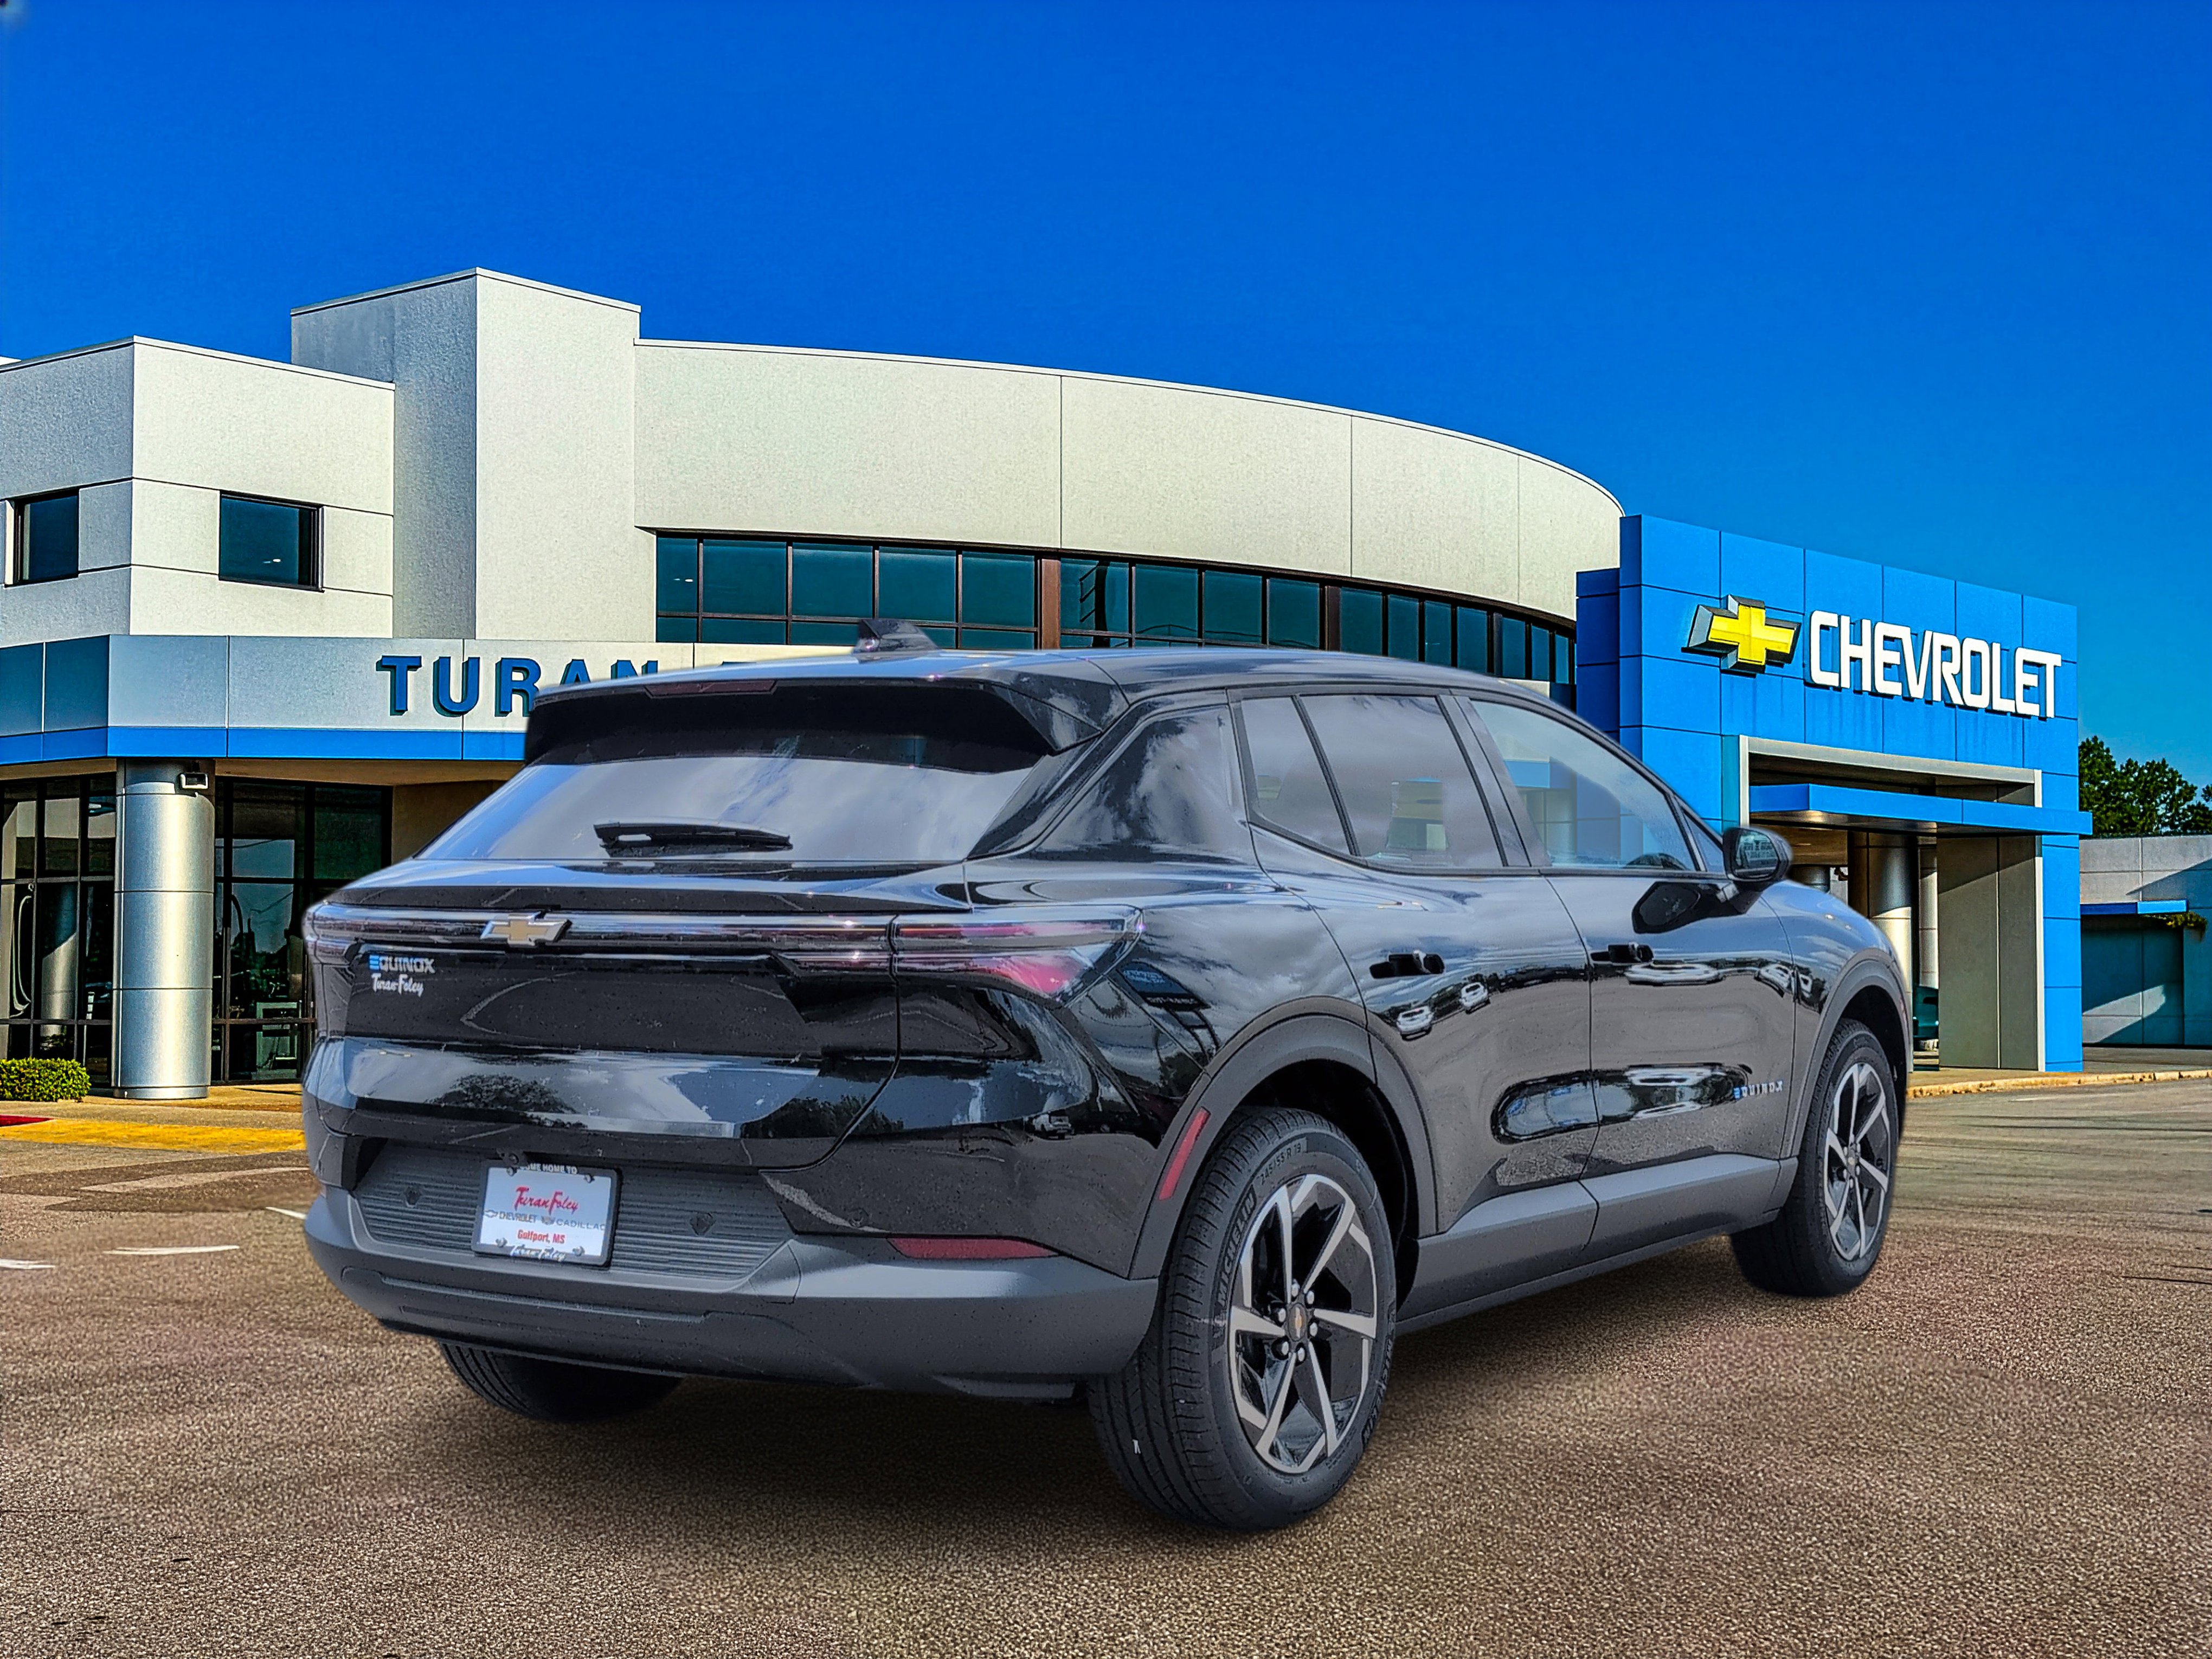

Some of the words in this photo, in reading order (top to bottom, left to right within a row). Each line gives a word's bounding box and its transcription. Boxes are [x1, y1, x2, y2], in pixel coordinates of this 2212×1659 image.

[1810, 610, 2061, 718] CHEVROLET
[369, 955, 435, 974] EQUINOX
[1733, 1081, 1783, 1099] EQUINOX
[499, 1211, 538, 1224] CHEVROLET
[556, 1220, 605, 1231] CADILLAC
[552, 1233, 565, 1244] MS
[1217, 1192, 1255, 1307] MICHELIN
